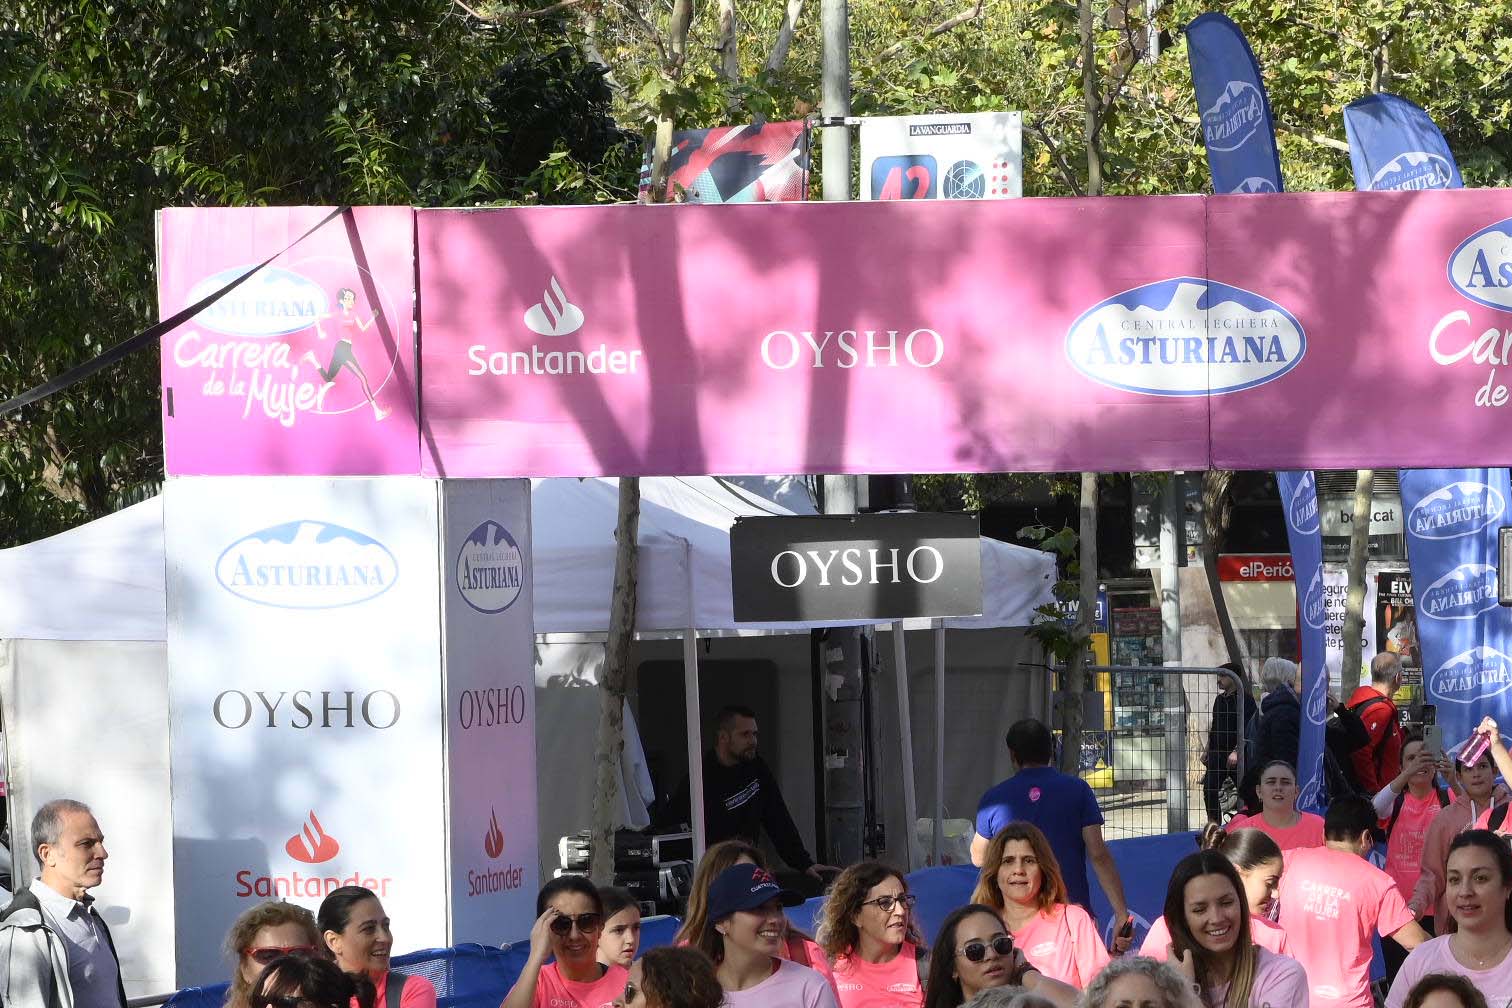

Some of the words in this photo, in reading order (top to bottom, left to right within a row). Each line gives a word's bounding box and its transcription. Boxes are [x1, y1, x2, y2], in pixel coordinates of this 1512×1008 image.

[1121, 319, 1195, 330] CENTRAL
[1202, 318, 1279, 329] LECHERA
[174, 330, 291, 368] Carrera
[467, 344, 642, 375] Santander
[760, 328, 944, 370] OYSHO
[1086, 324, 1288, 365] ASTURIANA
[202, 370, 224, 396] de
[229, 368, 244, 396] la
[241, 365, 335, 427] Mujer
[1474, 369, 1508, 407] de
[231, 553, 385, 588] ASTURIANA
[461, 554, 519, 591] ASTURIANA
[770, 546, 944, 588] OYSHO
[1239, 561, 1294, 578] elPerió
[1391, 581, 1412, 593] ELV
[213, 689, 400, 729] OYSHO
[459, 685, 525, 729] OYSHO
[468, 865, 523, 896] Santander
